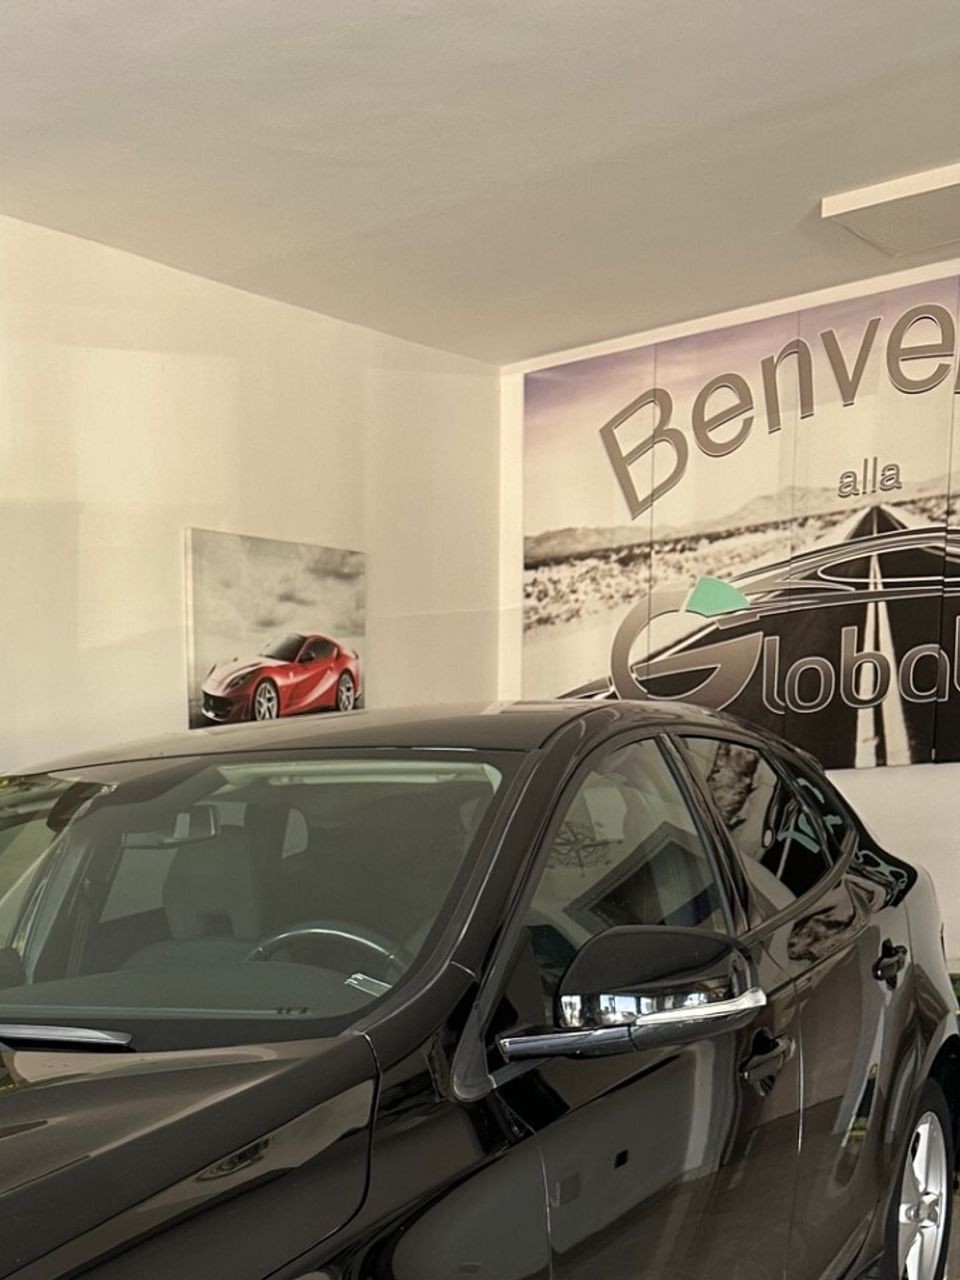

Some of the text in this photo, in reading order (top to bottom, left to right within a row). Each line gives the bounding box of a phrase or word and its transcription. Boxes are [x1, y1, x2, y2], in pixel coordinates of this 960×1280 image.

[599, 303, 960, 520] Benve
[837, 456, 902, 497] alla
[610, 576, 960, 714] Globa
